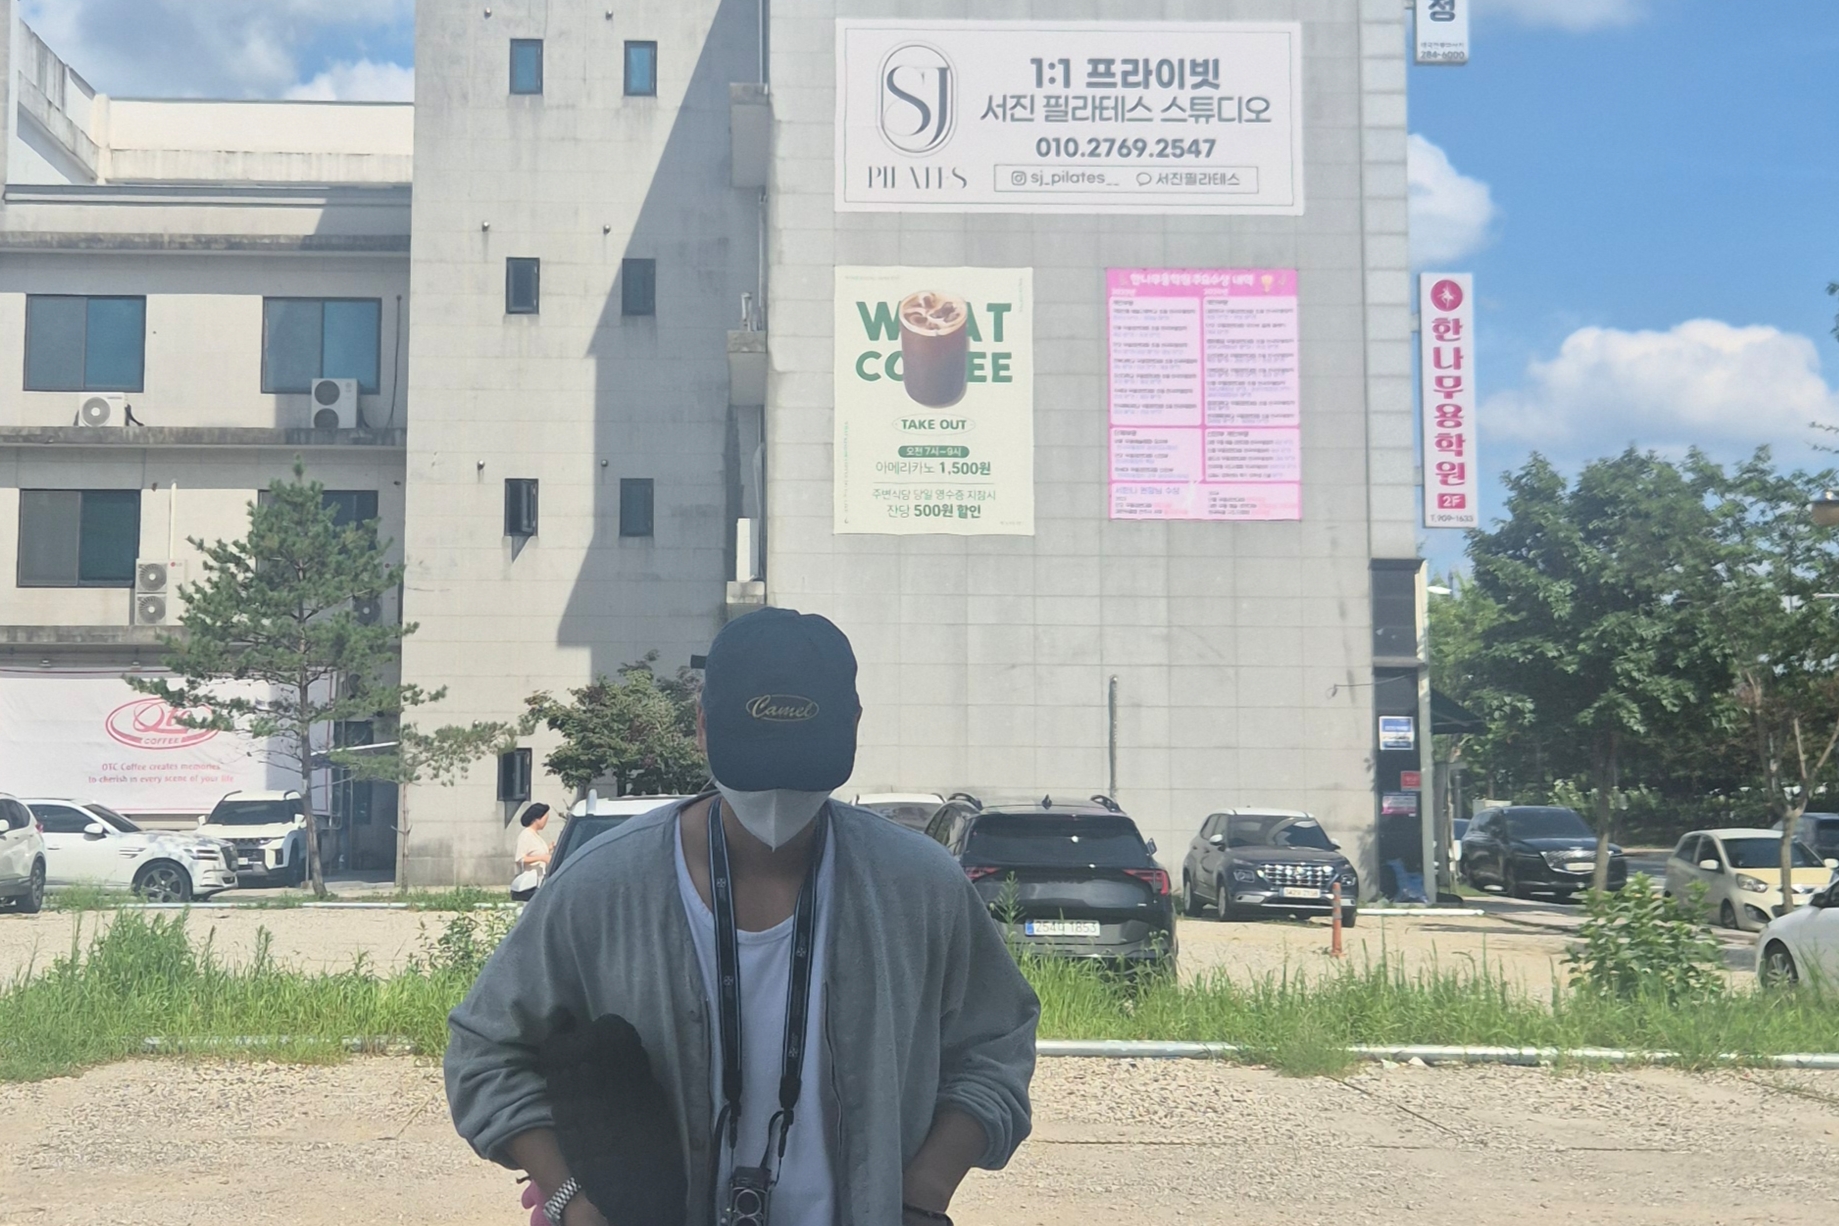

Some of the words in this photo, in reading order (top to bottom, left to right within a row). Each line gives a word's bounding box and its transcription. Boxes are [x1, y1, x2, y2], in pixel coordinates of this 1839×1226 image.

[1420, 50, 1465, 60] 284-6000
[1030, 57, 1071, 89] 1:1
[1085, 57, 1221, 91] 프라이빗
[979, 94, 1035, 123] 서진
[1042, 94, 1154, 124] 필라테스
[1160, 95, 1273, 125] 스튜디오
[1035, 136, 1217, 159] 010.2769.2547
[1155, 171, 1241, 187] 서진필라테스
[1432, 316, 1467, 486] 한나무용학원
[901, 419, 935, 430] TAKE
[939, 419, 967, 430] OUT
[906, 446, 923, 457] 오전
[875, 461, 935, 475] 아메리카노
[939, 461, 991, 476] 1,500원
[872, 488, 911, 501] 주변식당
[913, 489, 932, 501] 당일
[935, 489, 964, 501] 영수증
[1442, 494, 1462, 508] 2F
[886, 504, 910, 518] 잔당
[913, 503, 954, 518] 500원
[956, 504, 981, 519] 할인
[752, 694, 814, 718] Camel
[143, 737, 180, 745] COFFEE
[102, 762, 117, 771] OTC
[120, 762, 147, 771] Coffee
[149, 763, 178, 771] creates
[88, 776, 97, 784] to
[99, 775, 128, 783] cherish
[140, 776, 162, 784] every
[200, 776, 219, 784] your
[1069, 920, 1097, 933] 1853
